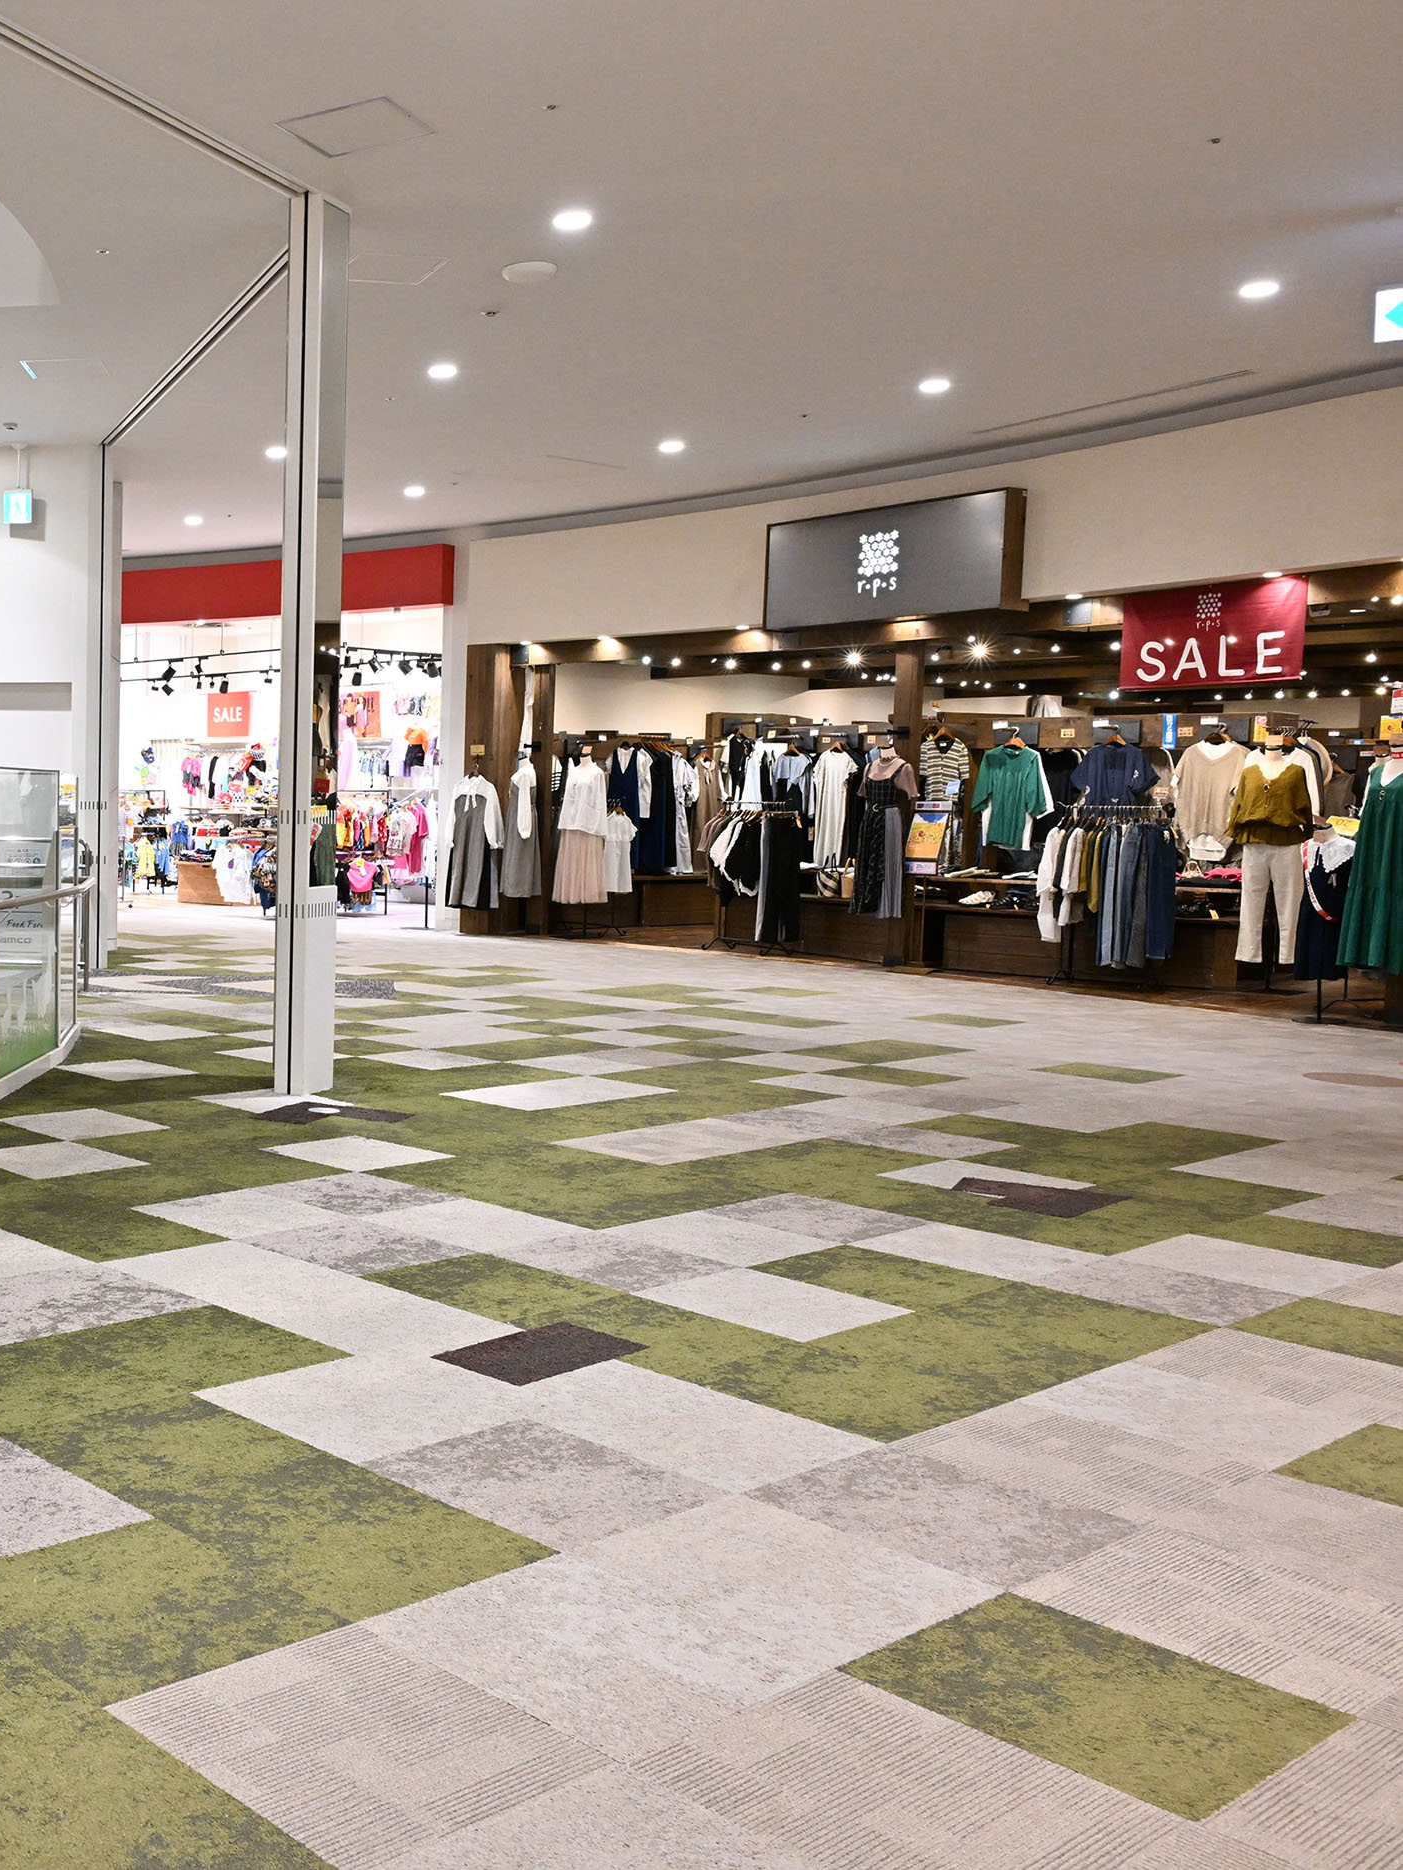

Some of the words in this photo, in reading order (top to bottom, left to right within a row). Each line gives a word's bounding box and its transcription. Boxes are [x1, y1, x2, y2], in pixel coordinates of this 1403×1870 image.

[1136, 630, 1285, 682] SALE
[213, 706, 243, 723] SALE
[7, 919, 25, 928] Food
